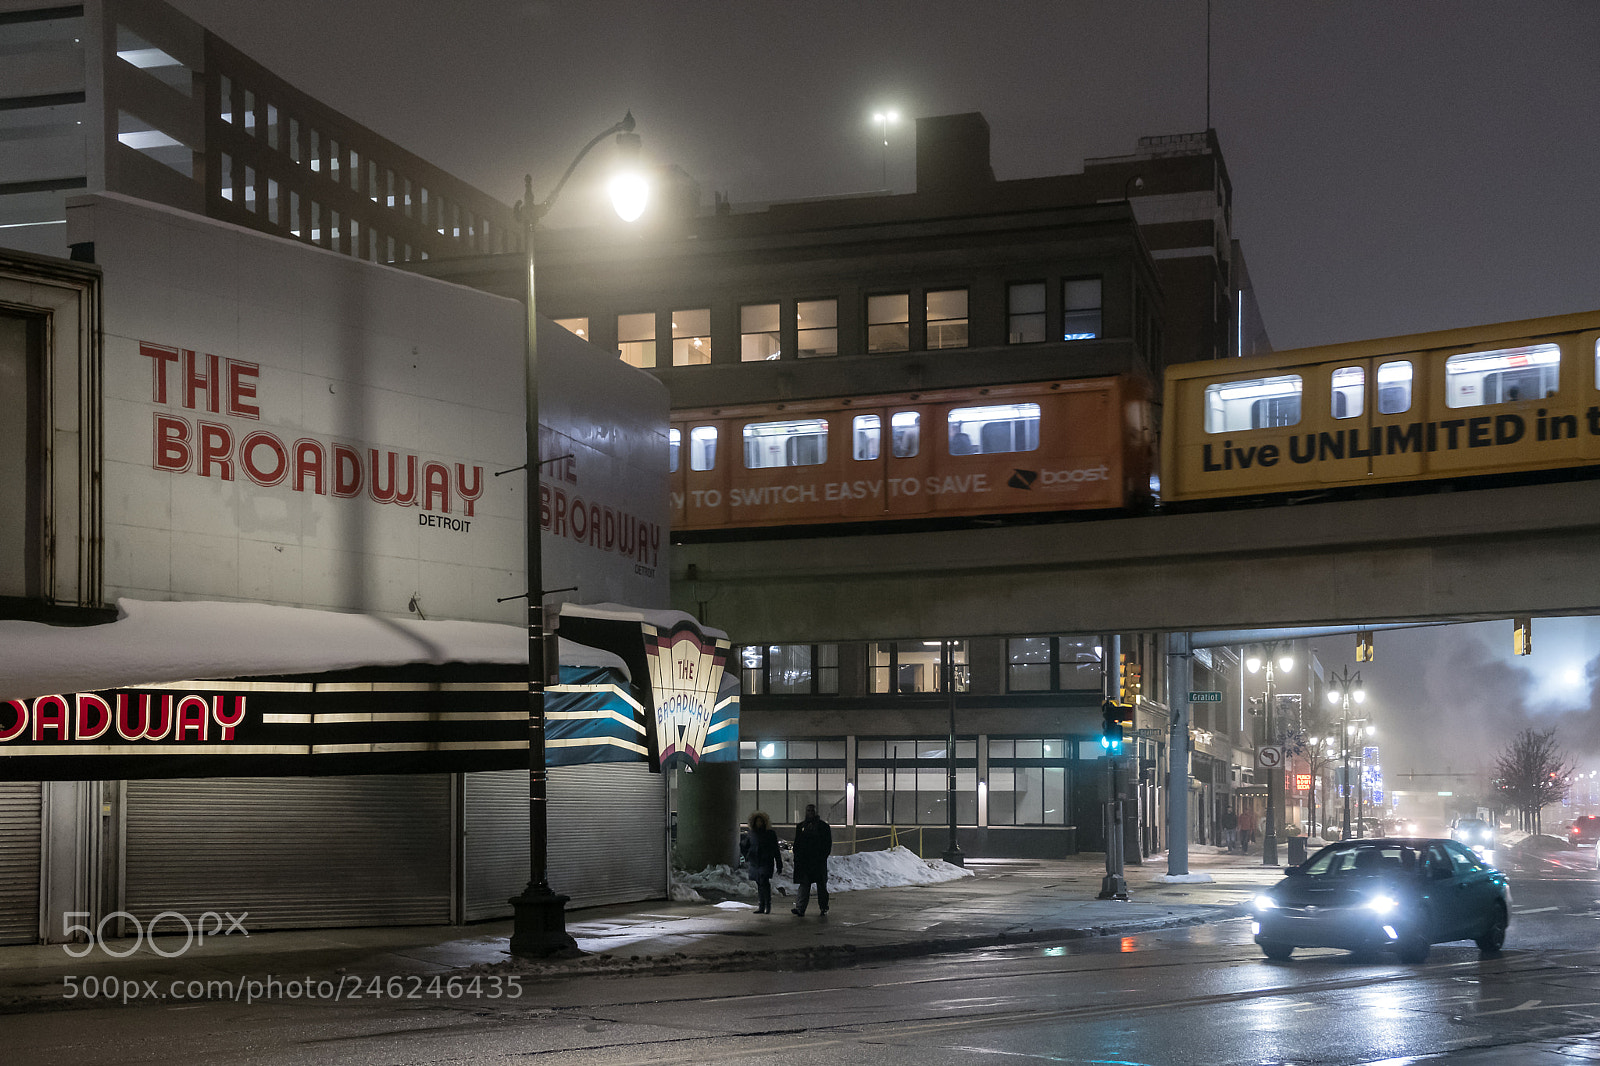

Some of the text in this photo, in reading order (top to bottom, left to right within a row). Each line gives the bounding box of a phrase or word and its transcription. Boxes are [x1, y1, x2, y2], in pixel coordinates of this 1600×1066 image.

[139, 340, 260, 420] THE
[1203, 440, 1280, 473] Live
[1289, 413, 1525, 464] UNLIMITED
[1536, 408, 1578, 442] in
[152, 412, 484, 517] BROADWAY
[539, 443, 578, 486] HE
[1041, 464, 1109, 485] boost
[692, 489, 722, 508] TO
[824, 480, 883, 501] EASY
[888, 477, 920, 497] TO
[419, 513, 471, 533] DETROIT
[539, 481, 661, 569] BROADWAY
[678, 660, 695, 680] THE
[657, 693, 710, 729] BROADWAY
[1192, 693, 1219, 701] Gratiot
